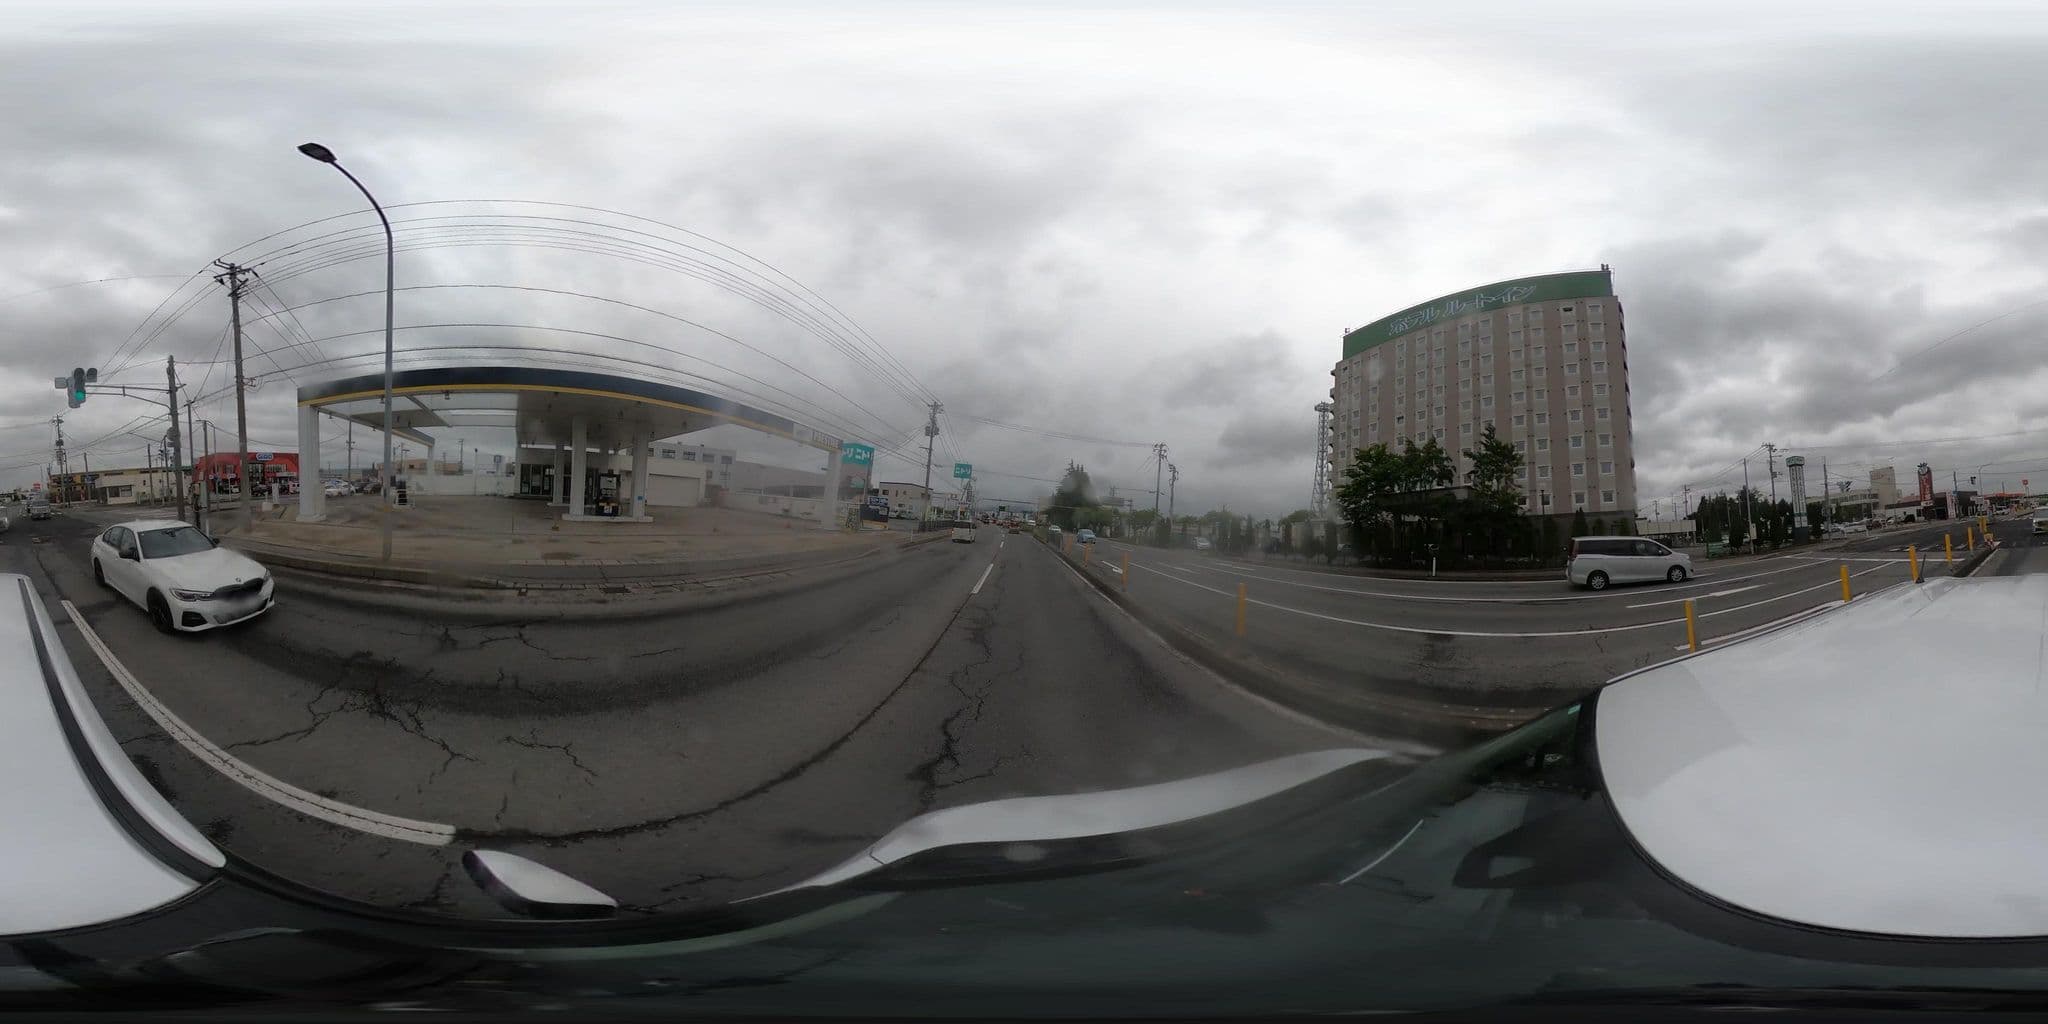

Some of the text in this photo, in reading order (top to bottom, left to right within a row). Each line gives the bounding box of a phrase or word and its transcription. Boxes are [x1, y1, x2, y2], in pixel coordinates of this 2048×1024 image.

[1388, 285, 1537, 336] ホテル ルートイン
